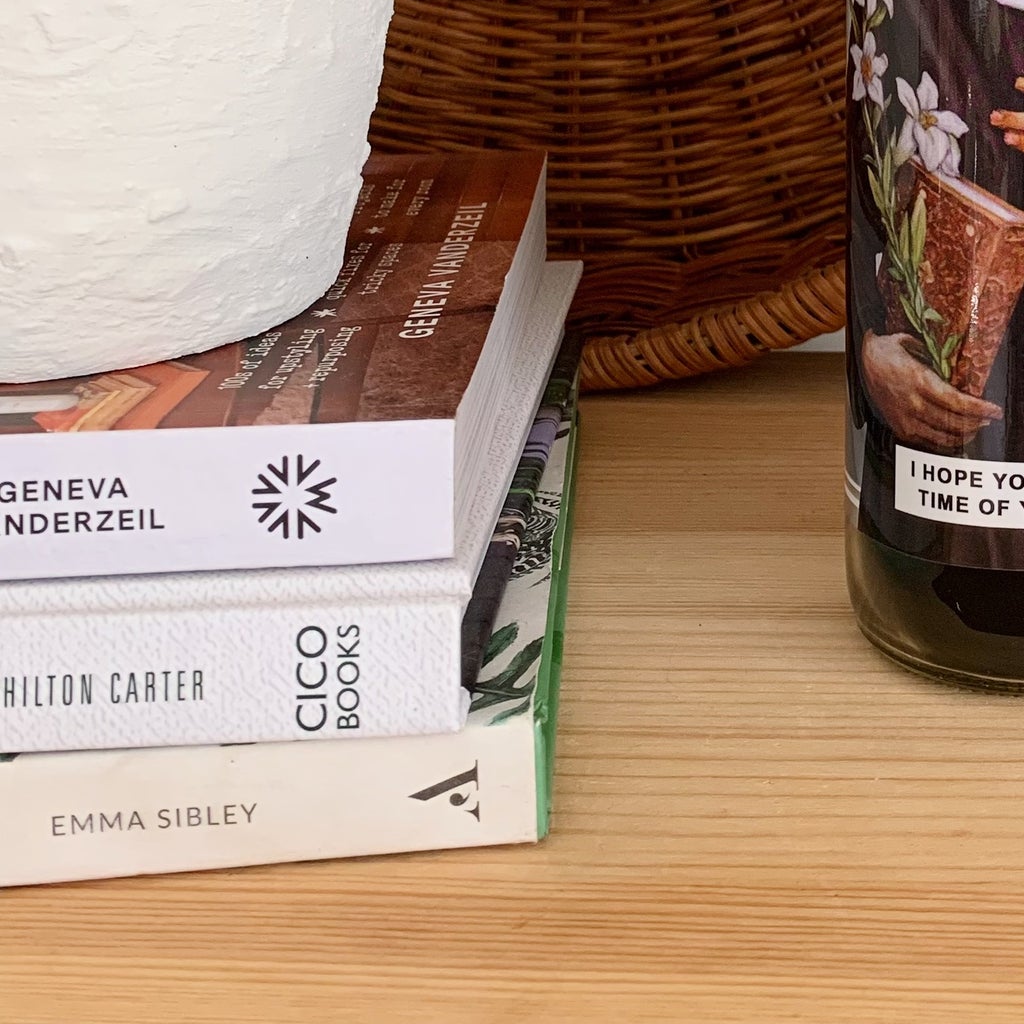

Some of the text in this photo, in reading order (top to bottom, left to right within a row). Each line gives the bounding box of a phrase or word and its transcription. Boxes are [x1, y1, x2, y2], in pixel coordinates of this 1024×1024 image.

[356, 243, 403, 295] tricky spaces
[398, 202, 489, 339] GENEVA VANDERZEIL
[217, 331, 282, 390] 100s of ideas
[258, 328, 325, 390] for upstyling
[309, 325, 362, 382] repurposing
[0, 477, 129, 504] GENEVA
[910, 460, 915, 478] I
[922, 463, 983, 488] HOPE
[0, 508, 165, 536] NDERZEIL
[918, 488, 969, 513] TIME
[978, 499, 1010, 516] OF
[3, 669, 204, 708] HILTON CARTER
[296, 625, 328, 732] CICO
[336, 624, 360, 730] BOOKS
[51, 802, 257, 837] EMMA SIBLEY
